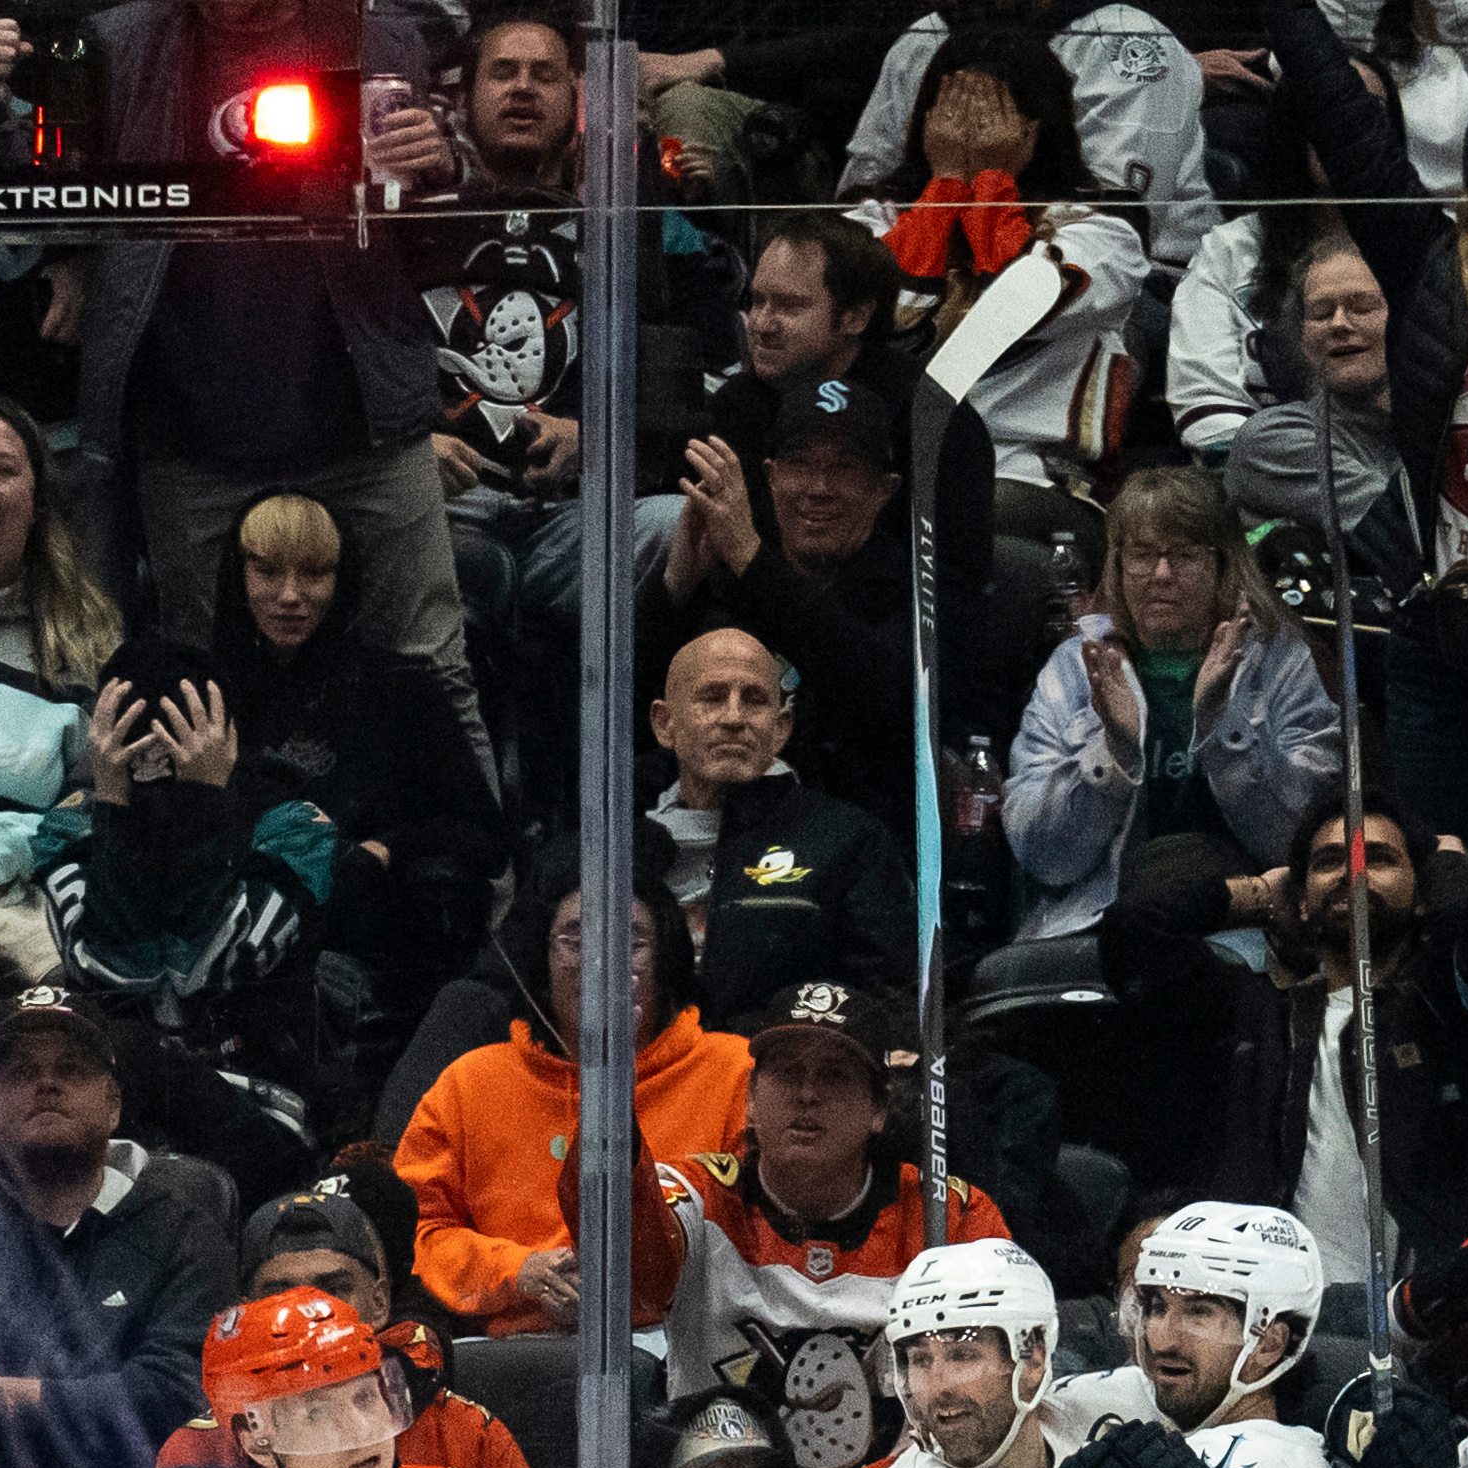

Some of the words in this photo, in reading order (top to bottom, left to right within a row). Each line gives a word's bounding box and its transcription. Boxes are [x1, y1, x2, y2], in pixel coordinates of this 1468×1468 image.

[931, 1079, 948, 1203] BAUER
[1175, 1216, 1207, 1232] 10
[901, 1293, 947, 1310] CCM
